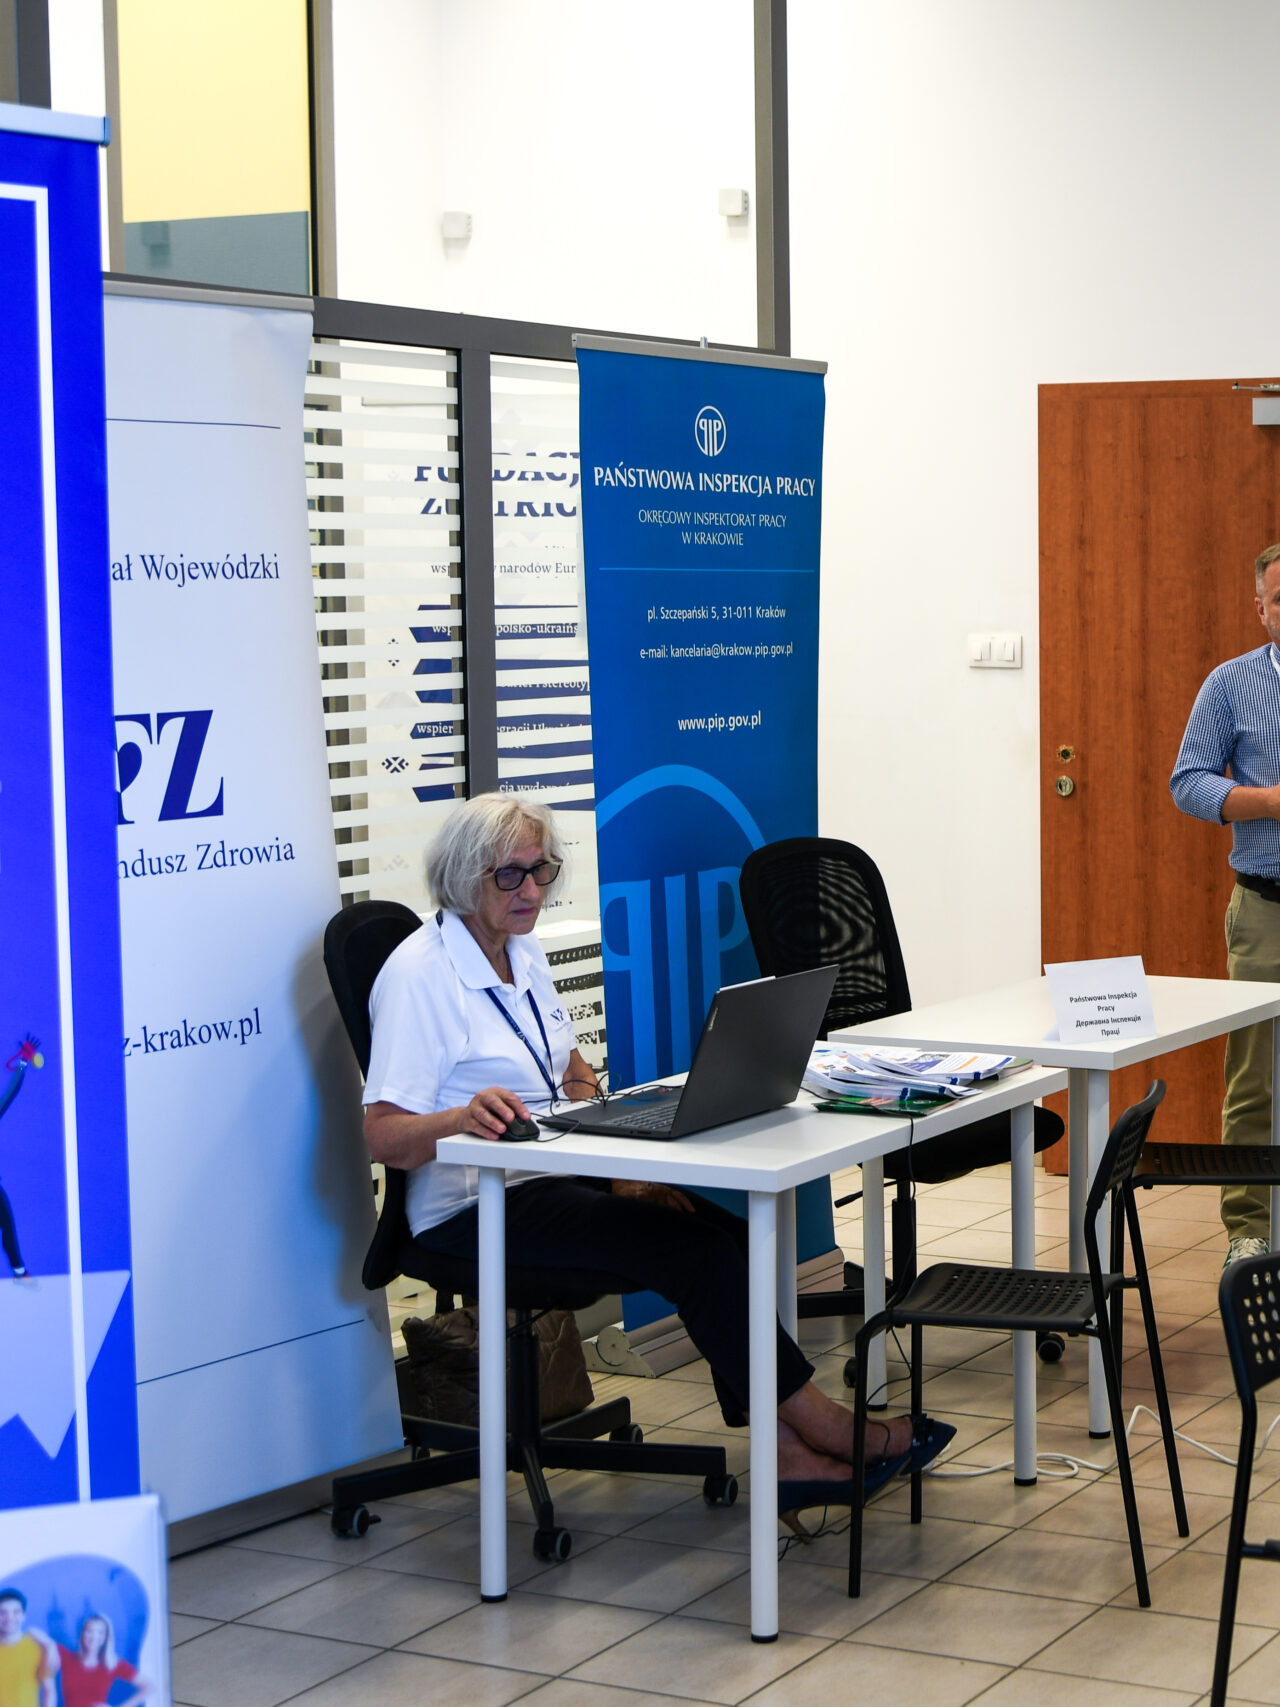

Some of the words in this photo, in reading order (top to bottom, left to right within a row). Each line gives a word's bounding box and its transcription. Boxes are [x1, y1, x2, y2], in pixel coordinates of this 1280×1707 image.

[594, 461, 695, 491] PAŃSTWOWA
[699, 472, 773, 498] INSPEKCJA
[776, 476, 816, 497] PRACY
[638, 509, 692, 527] OKRĘGOWY
[693, 512, 756, 527] INSPEKTORAT
[758, 514, 787, 528] PRACY
[681, 531, 692, 544] W
[694, 531, 744, 546] KRAKOWIE
[111, 554, 134, 581] ał
[140, 553, 280, 588] Wojewódzki
[499, 562, 551, 574] narodów
[555, 563, 577, 574] Eur
[647, 606, 658, 623] pl.
[660, 605, 709, 622] Szczepański
[711, 606, 720, 621] 5,
[722, 606, 752, 619] 31-011
[756, 605, 787, 618] Kraków
[496, 623, 578, 636] polsko-ukraińs
[640, 644, 669, 659] e-mail:
[670, 641, 793, 659] kancelaria@krakow.pip.gov.pl
[417, 723, 453, 735] wspier
[678, 710, 762, 732] www.pip.gov.pl
[117, 848, 188, 880] ndusz
[196, 837, 296, 871] Zdrowia
[1069, 993, 1107, 1003] Państwowa
[1107, 991, 1138, 1001] Inspekcja
[1097, 1004, 1115, 1013] Pracy
[122, 1006, 263, 1058] z-krakow.pl
